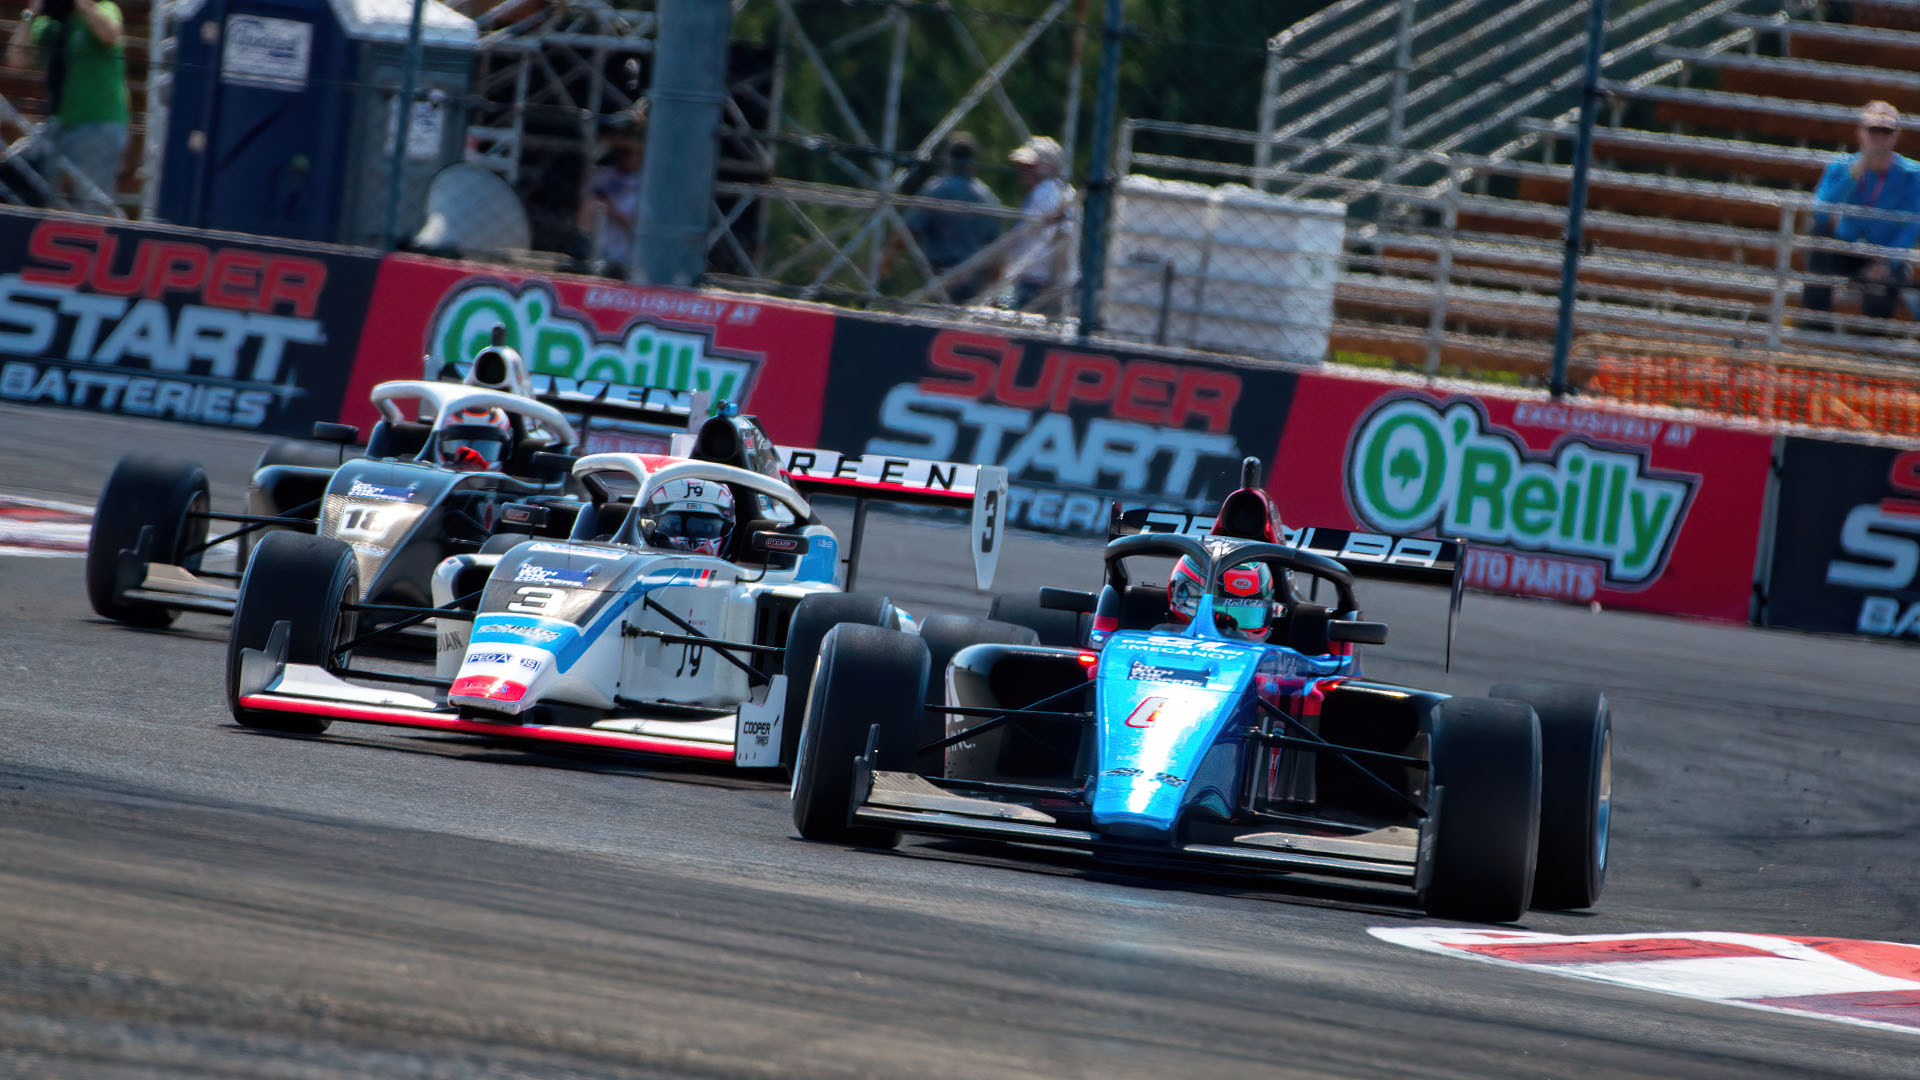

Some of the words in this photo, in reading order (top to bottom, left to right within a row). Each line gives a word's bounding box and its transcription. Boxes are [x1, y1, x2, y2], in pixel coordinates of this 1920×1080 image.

[20, 219, 328, 318] SUPER
[0, 272, 328, 384] START
[728, 303, 760, 325] AT
[1, 361, 273, 429] BATTERIES
[919, 329, 1243, 434] SUPER
[865, 382, 1242, 497] START
[1664, 421, 1697, 448] AT
[787, 450, 958, 490] REEN
[1362, 412, 1675, 567] O'Reilly
[980, 490, 999, 553] 3
[507, 586, 568, 616] 3
[1511, 554, 1597, 601] PARTS
[743, 720, 771, 736] COOPER
